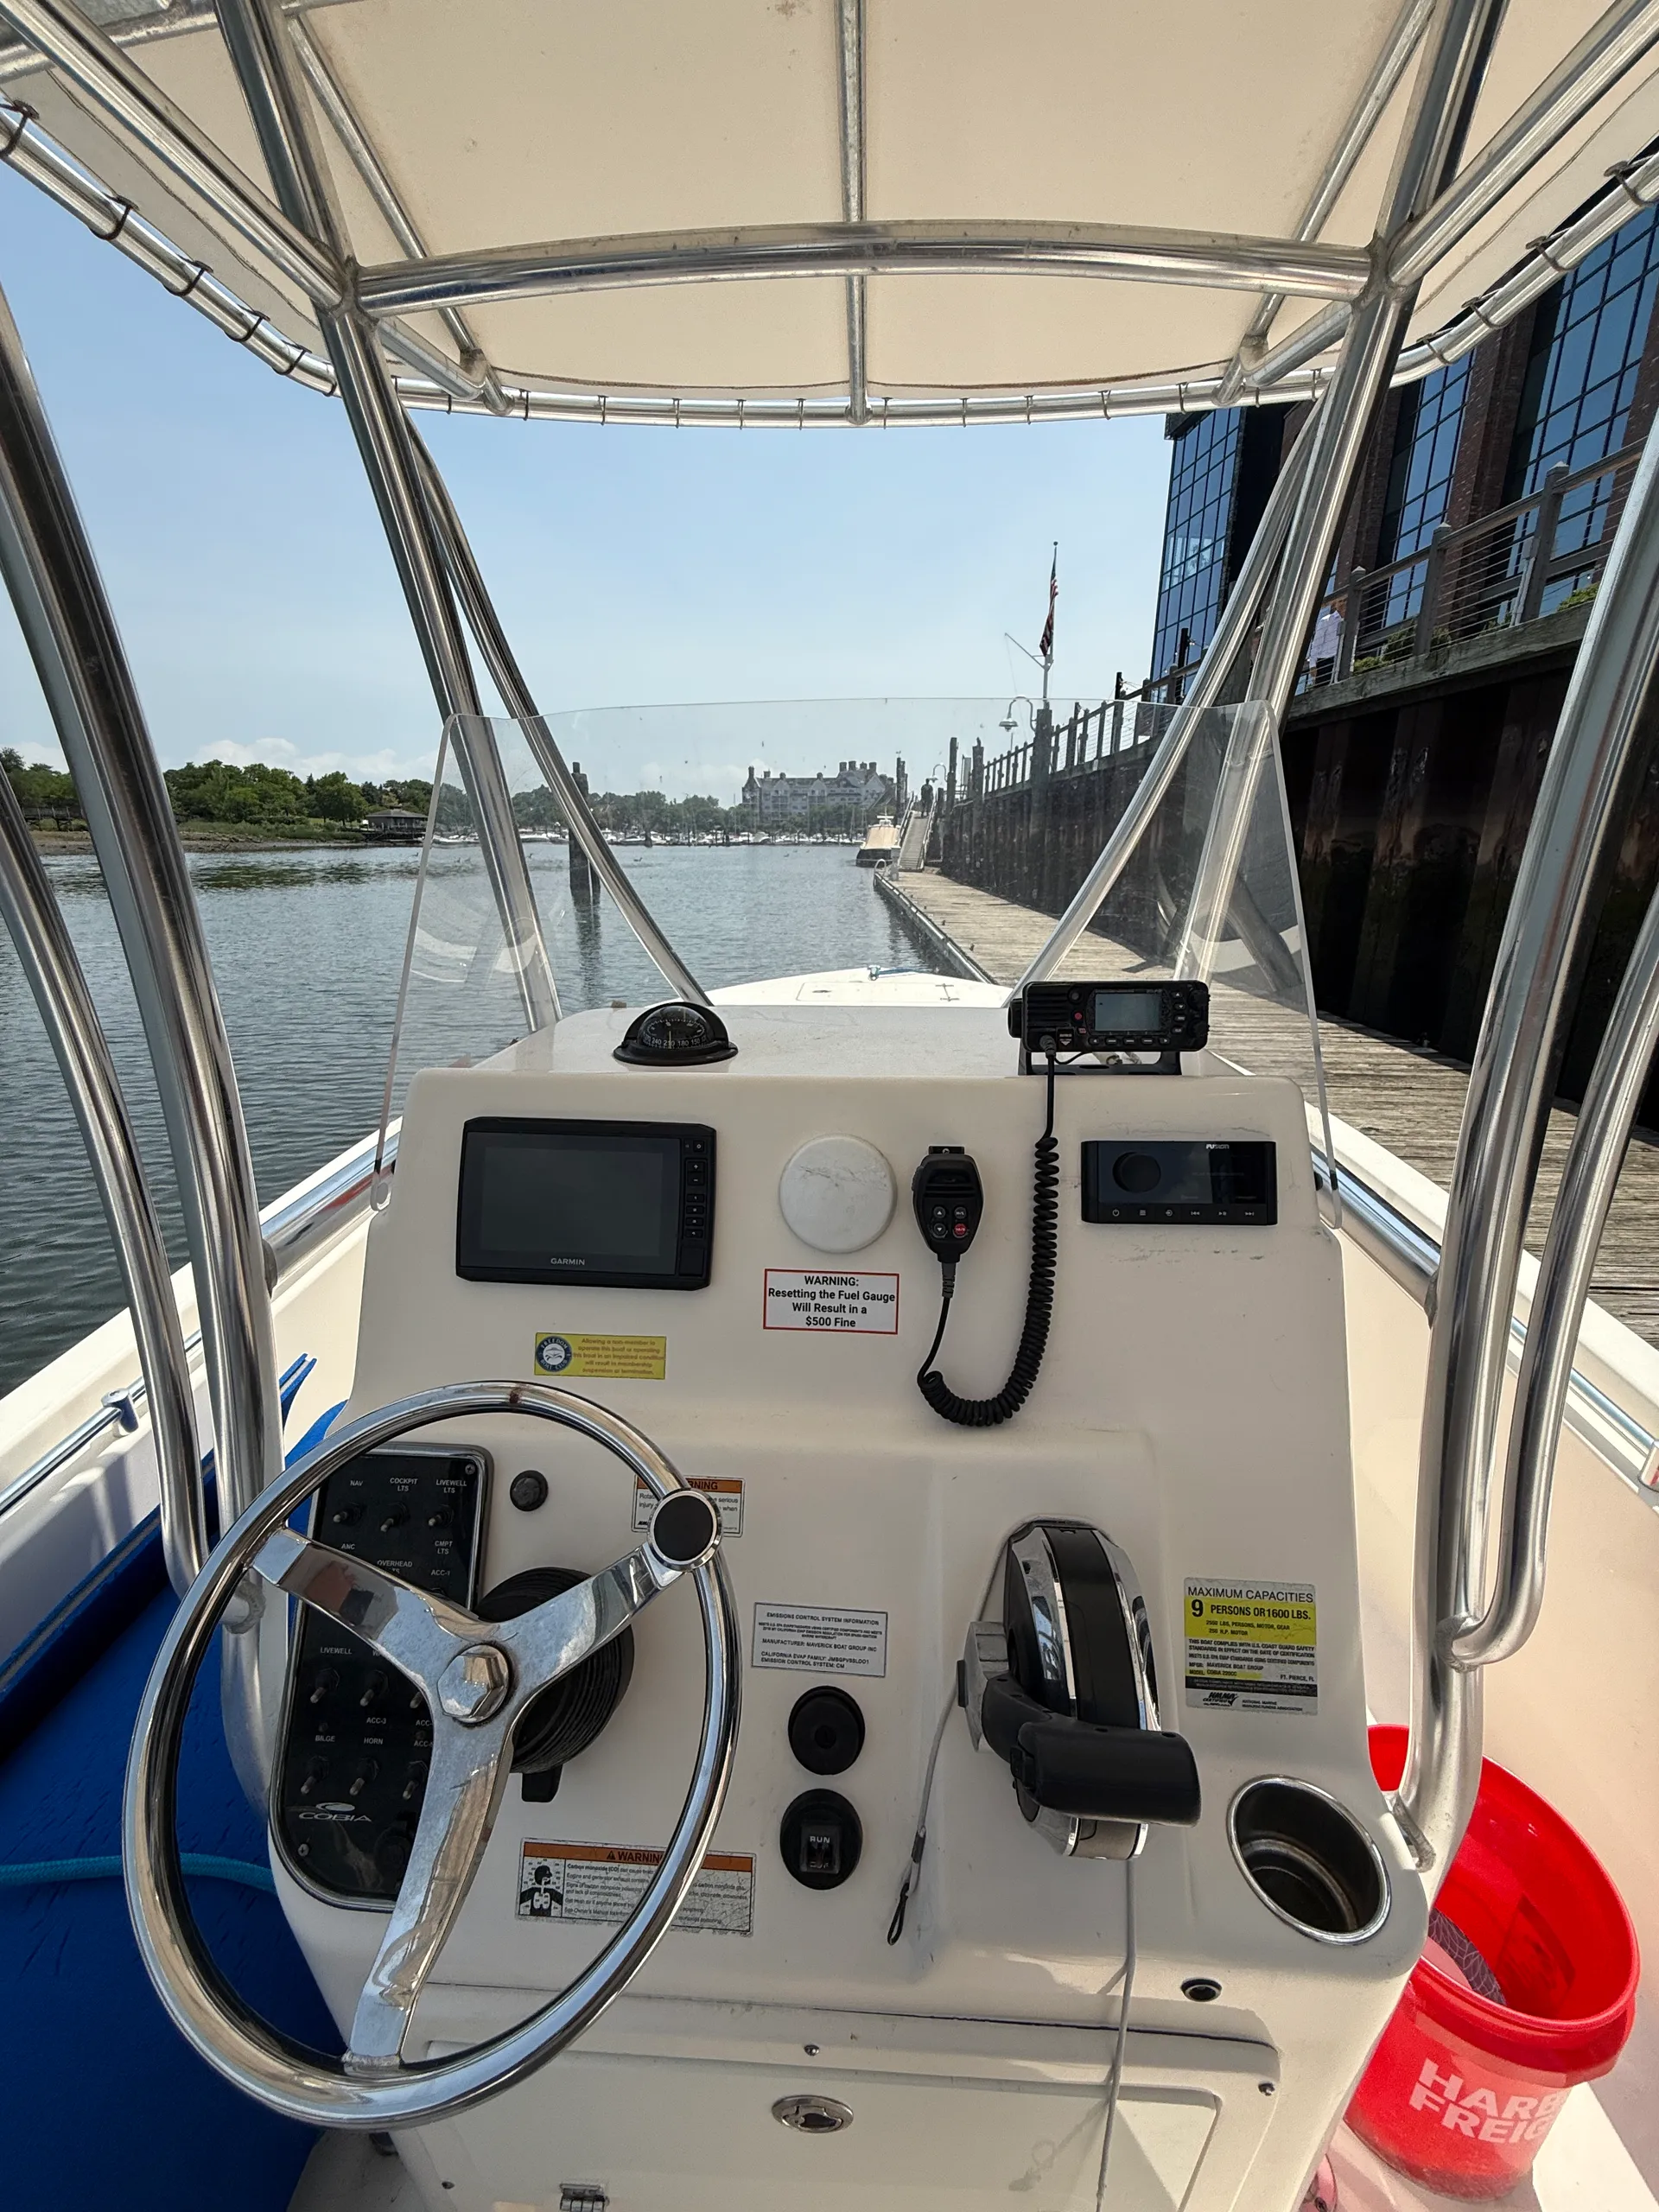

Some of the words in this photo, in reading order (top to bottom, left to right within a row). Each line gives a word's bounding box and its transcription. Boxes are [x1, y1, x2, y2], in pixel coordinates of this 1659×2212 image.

[550, 1257, 586, 1266] GARMIN
[804, 1275, 859, 1287] WARNING:
[768, 1287, 817, 1301] Resetting
[818, 1289, 836, 1300] the
[838, 1290, 860, 1300] Fuel
[862, 1291, 895, 1304] Gauge
[792, 1302, 811, 1313] Will
[814, 1303, 846, 1313] Result
[849, 1305, 858, 1313] in
[805, 1316, 831, 1326] $500
[834, 1318, 856, 1327] Fine
[1188, 1586, 1243, 1599] MAXIMUM
[1246, 1590, 1313, 1603] CAPACITIES
[1192, 1599, 1204, 1617] 9
[1211, 1605, 1251, 1616] PERSONS
[1254, 1607, 1266, 1617] OR
[1267, 1608, 1290, 1618] 1600
[1291, 1610, 1312, 1619] LBS.
[762, 1638, 805, 1647] MANUFACTURER:
[298, 1812, 372, 1822] COBIA
